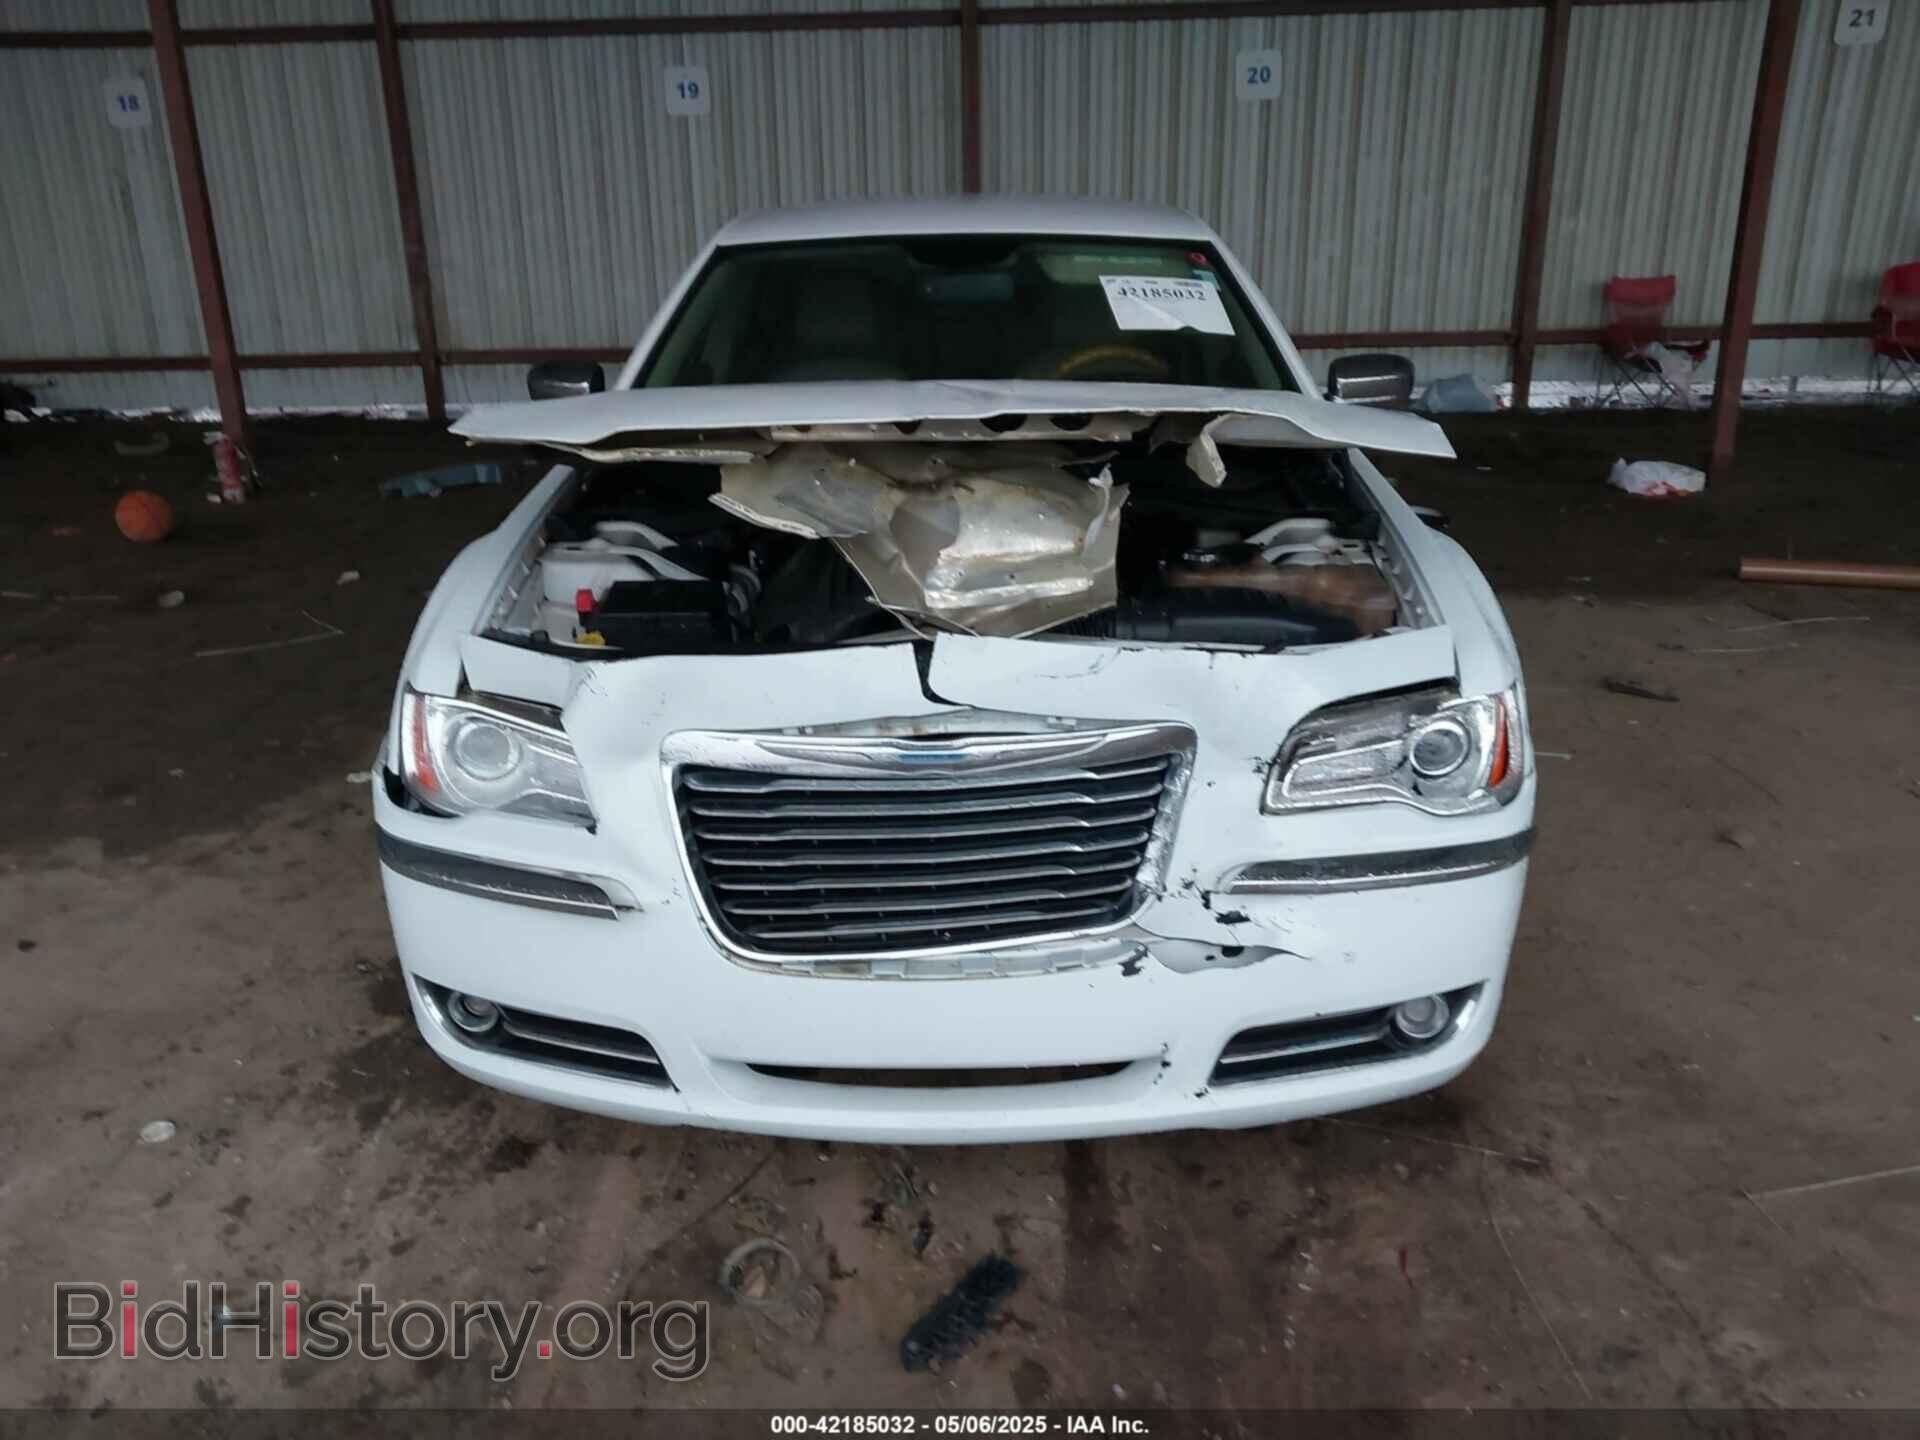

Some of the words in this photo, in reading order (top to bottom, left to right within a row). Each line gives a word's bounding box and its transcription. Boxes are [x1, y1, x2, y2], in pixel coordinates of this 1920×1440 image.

[1849, 9, 1876, 27] 21
[1247, 65, 1272, 84] 20
[677, 81, 699, 100] 19
[116, 94, 140, 112] 18
